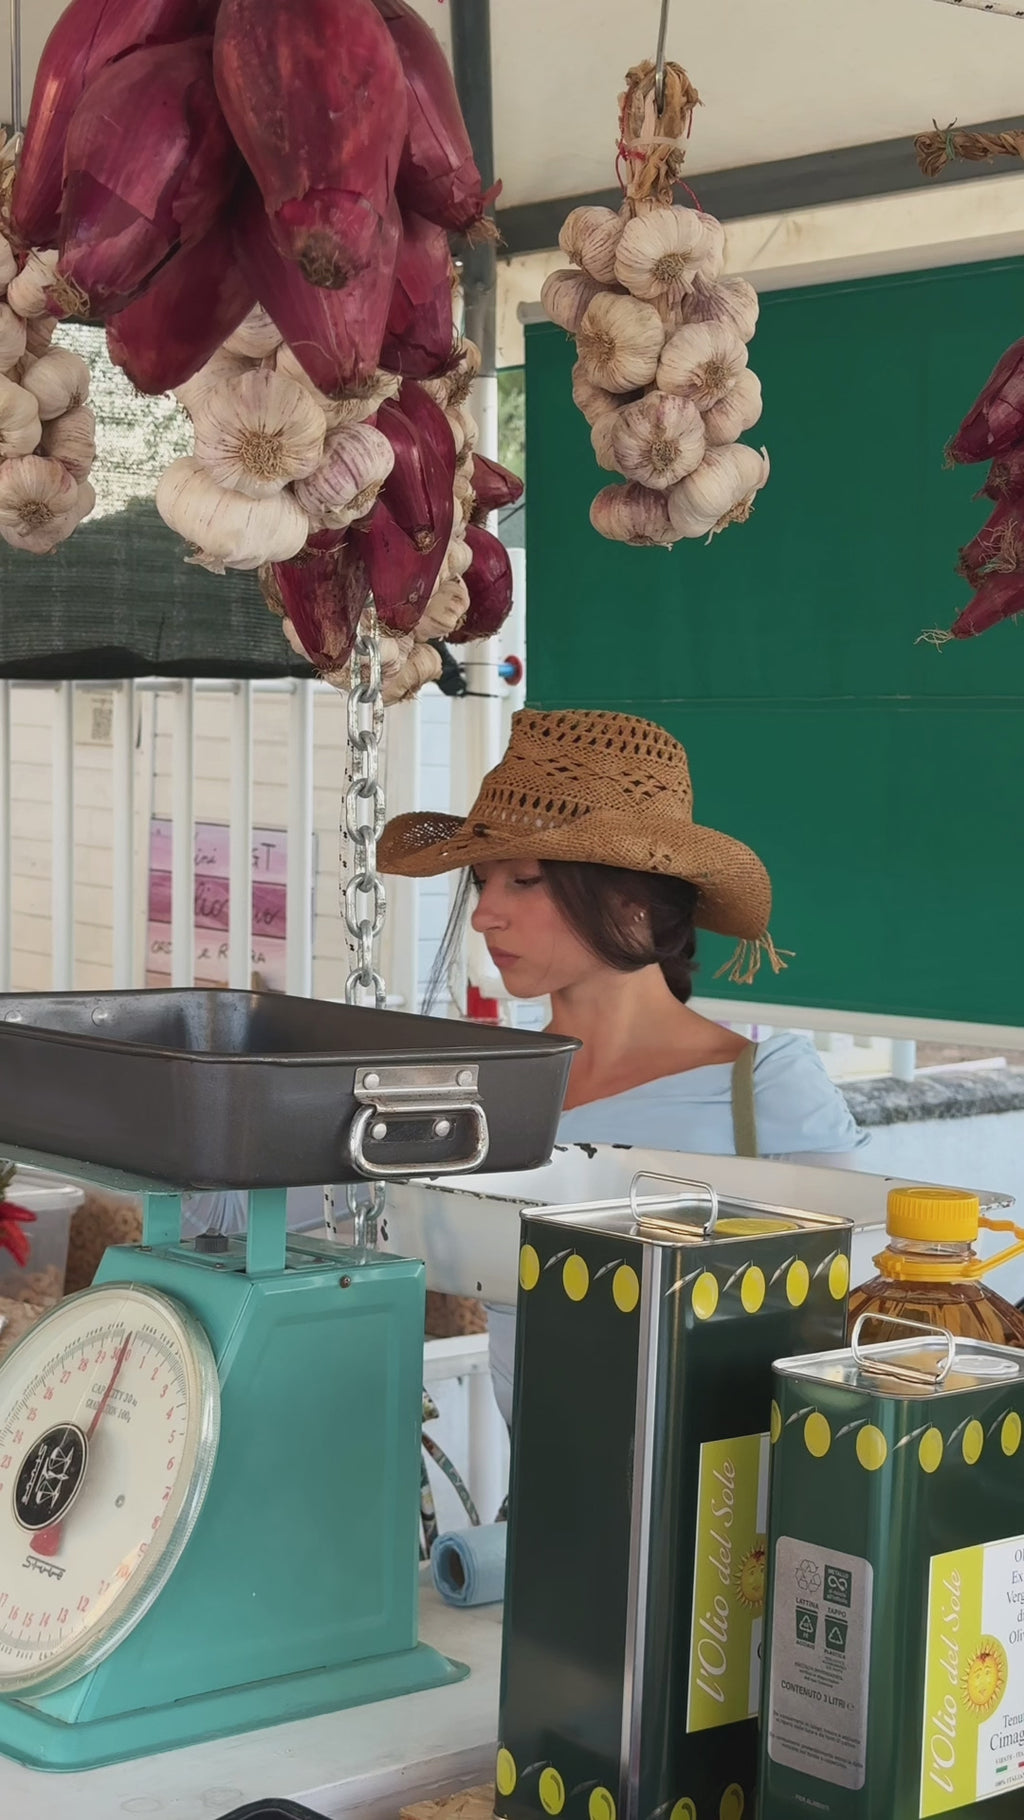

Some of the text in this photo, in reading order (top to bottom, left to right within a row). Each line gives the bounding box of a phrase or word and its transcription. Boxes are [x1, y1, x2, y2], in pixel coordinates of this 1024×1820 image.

[139, 1355, 146, 1369] 1
[150, 1366, 159, 1381] 2
[160, 1384, 169, 1398] 3
[165, 1406, 174, 1420] 4
[168, 1430, 176, 1444] 5
[166, 1456, 175, 1471] 6
[711, 1457, 736, 1528] Sole
[151, 1515, 161, 1530] 8
[708, 1529, 732, 1585] del
[77, 1595, 90, 1612] 12
[941, 1568, 962, 1633] Sole
[8, 1606, 20, 1621] 16
[22, 1611, 34, 1628] 15
[40, 1612, 51, 1628] 14
[57, 1607, 69, 1624] 13
[939, 1633, 959, 1685] del
[781, 1680, 822, 1701] CONTENUTO
